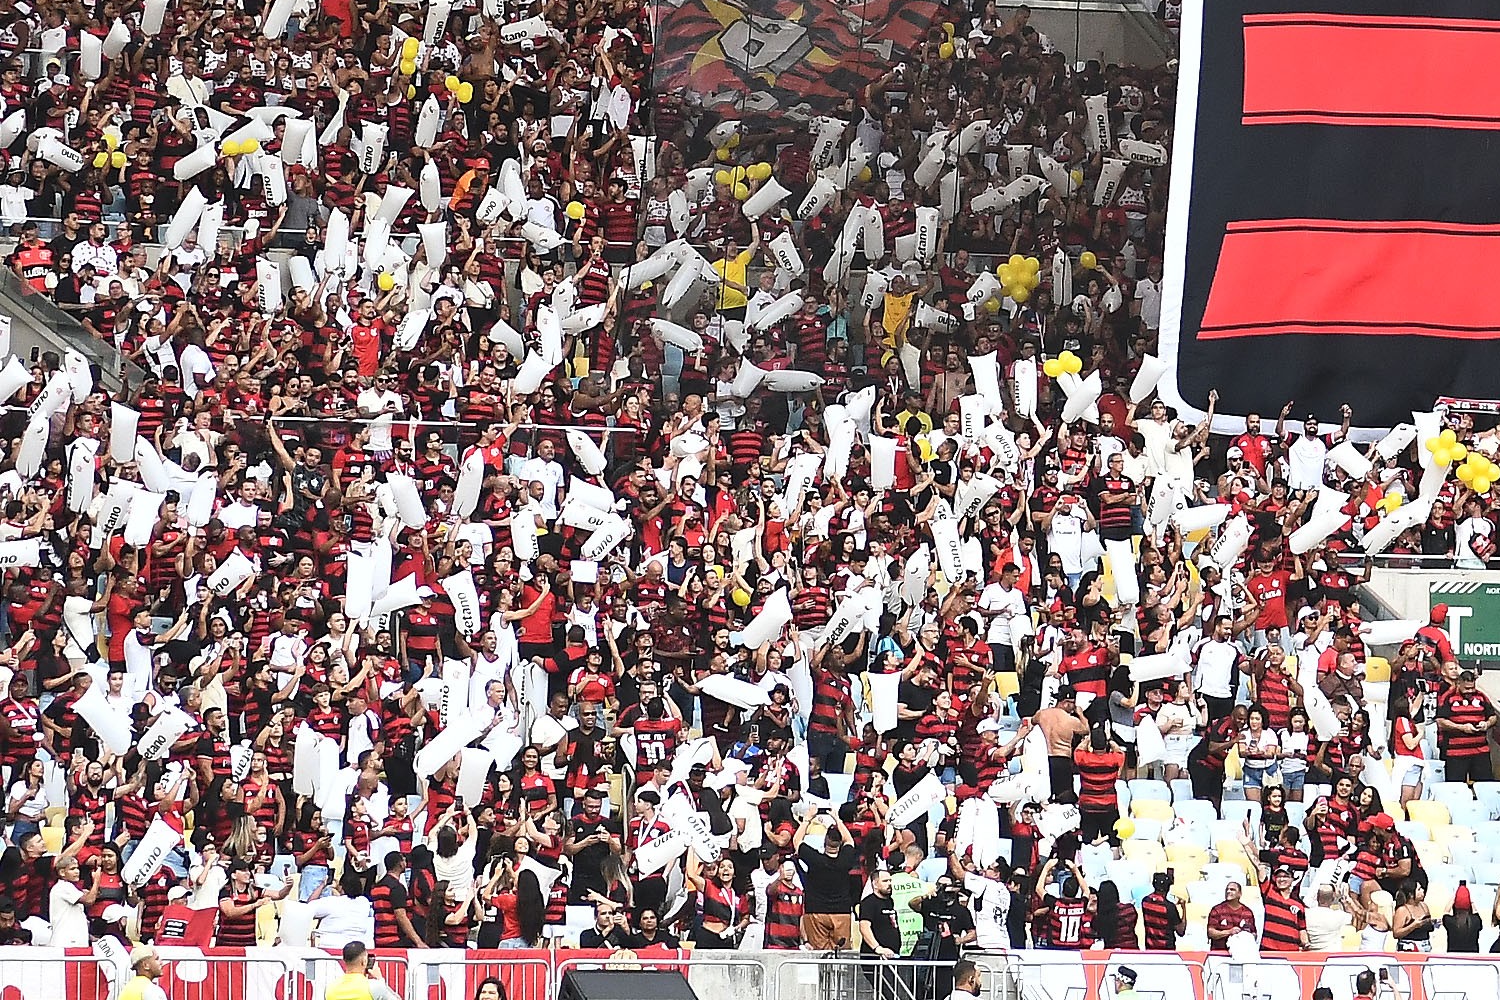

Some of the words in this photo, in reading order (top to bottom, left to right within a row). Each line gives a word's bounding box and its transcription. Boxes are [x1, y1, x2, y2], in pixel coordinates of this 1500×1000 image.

[1446, 606, 1473, 654] T
[144, 734, 166, 760] etano
[889, 792, 921, 822] etano
[132, 845, 162, 888] etano
[1058, 915, 1082, 942] 10
